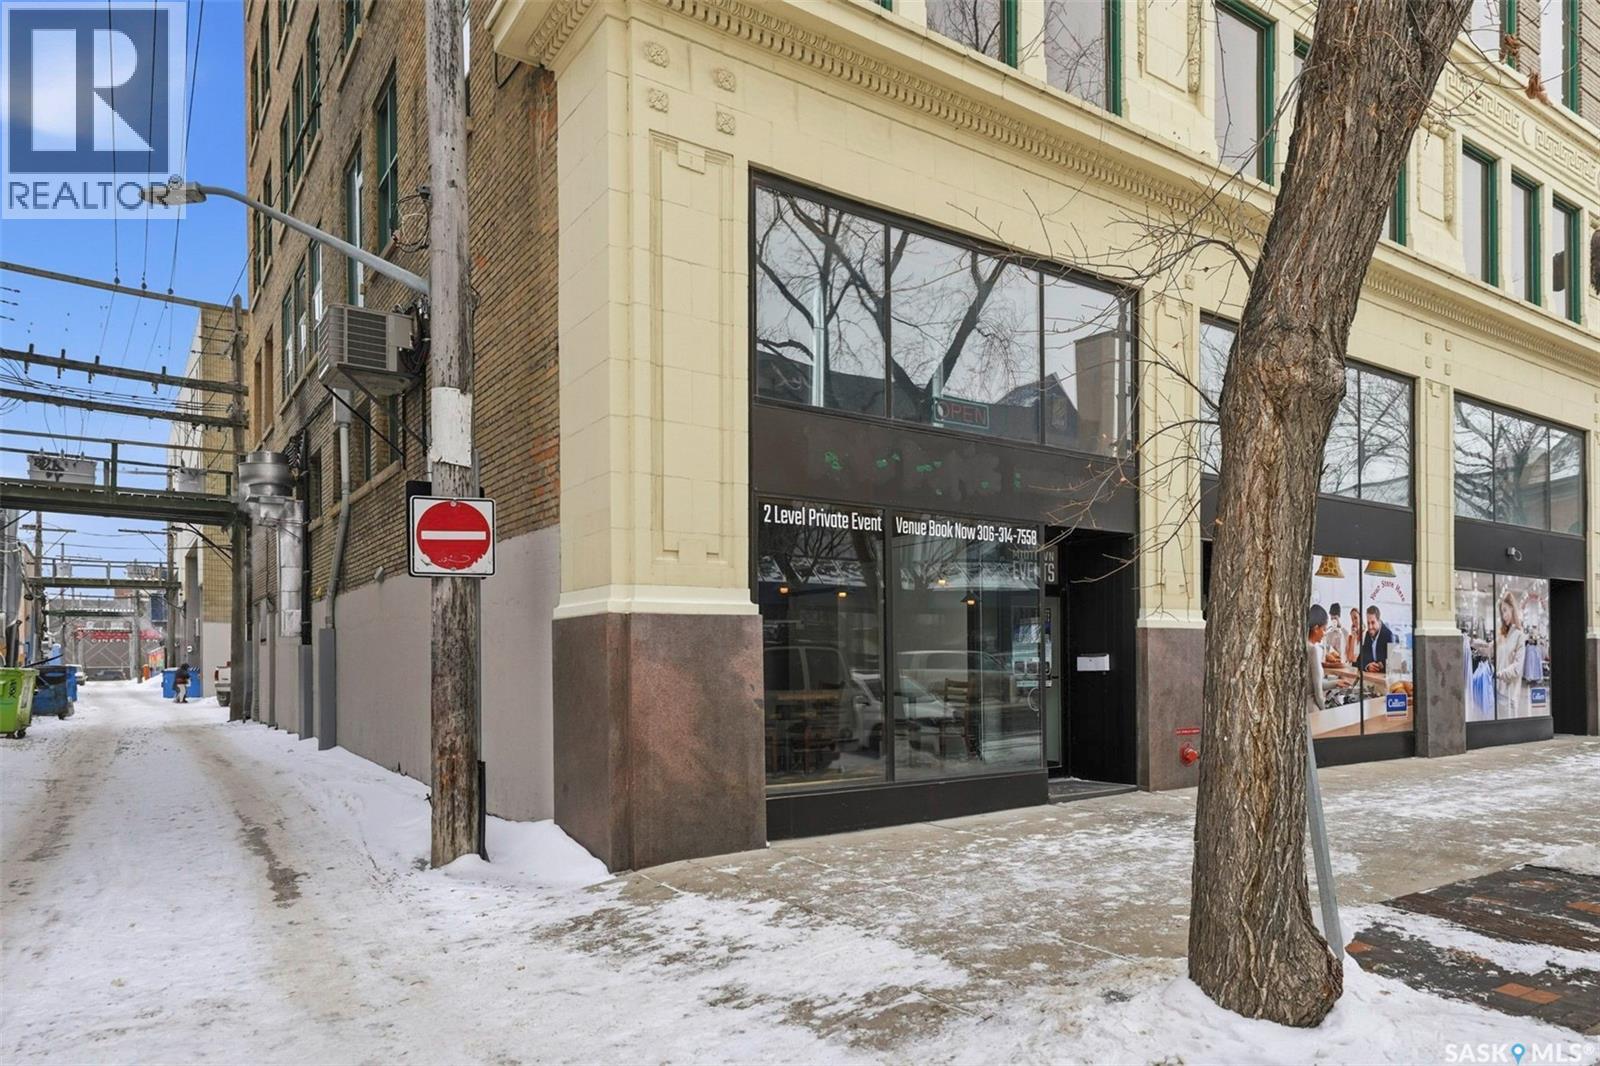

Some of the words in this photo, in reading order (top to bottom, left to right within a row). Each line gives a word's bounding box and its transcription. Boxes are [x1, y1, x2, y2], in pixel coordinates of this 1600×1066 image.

[936, 401, 987, 424] OPEN
[763, 504, 772, 523] 2
[774, 505, 806, 526] Level
[808, 507, 849, 529] Private
[851, 512, 883, 532] Event
[896, 516, 927, 536] Venue
[928, 520, 954, 539] Book
[954, 523, 976, 540] Now
[977, 525, 1037, 546] 306-314-7558
